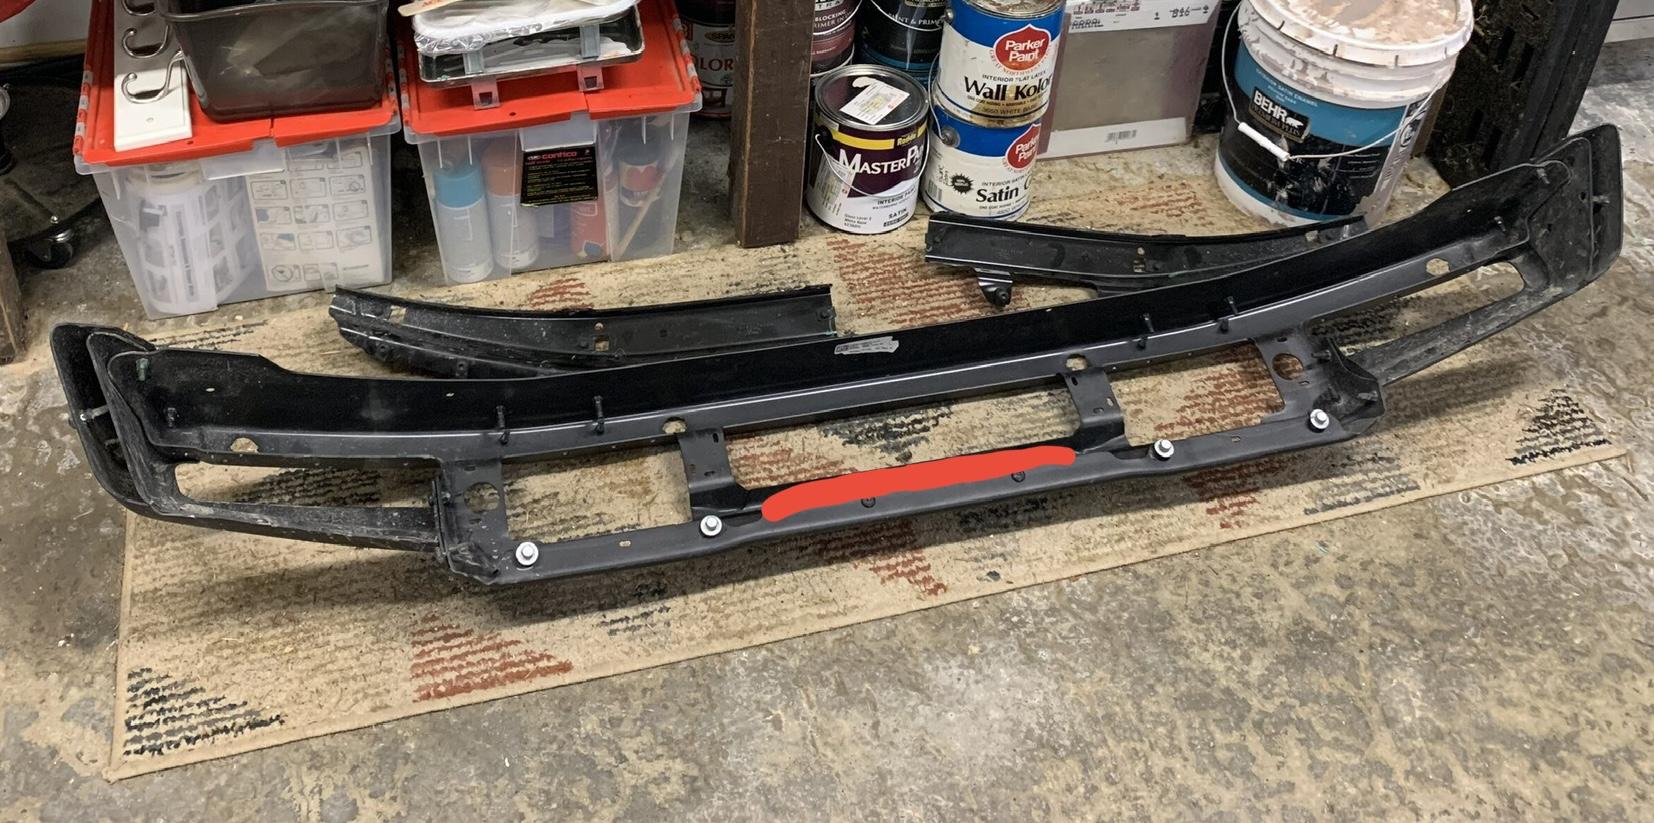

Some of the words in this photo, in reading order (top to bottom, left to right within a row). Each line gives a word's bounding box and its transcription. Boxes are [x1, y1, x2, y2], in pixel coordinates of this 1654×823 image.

[1005, 38, 1046, 52] Parker
[1009, 49, 1040, 62] Paint
[982, 74, 1014, 83] INTERIOR
[964, 75, 1008, 101] Wall
[1253, 90, 1288, 123] BEHR
[975, 185, 1019, 203] Satin
[888, 207, 908, 219] SATIN
